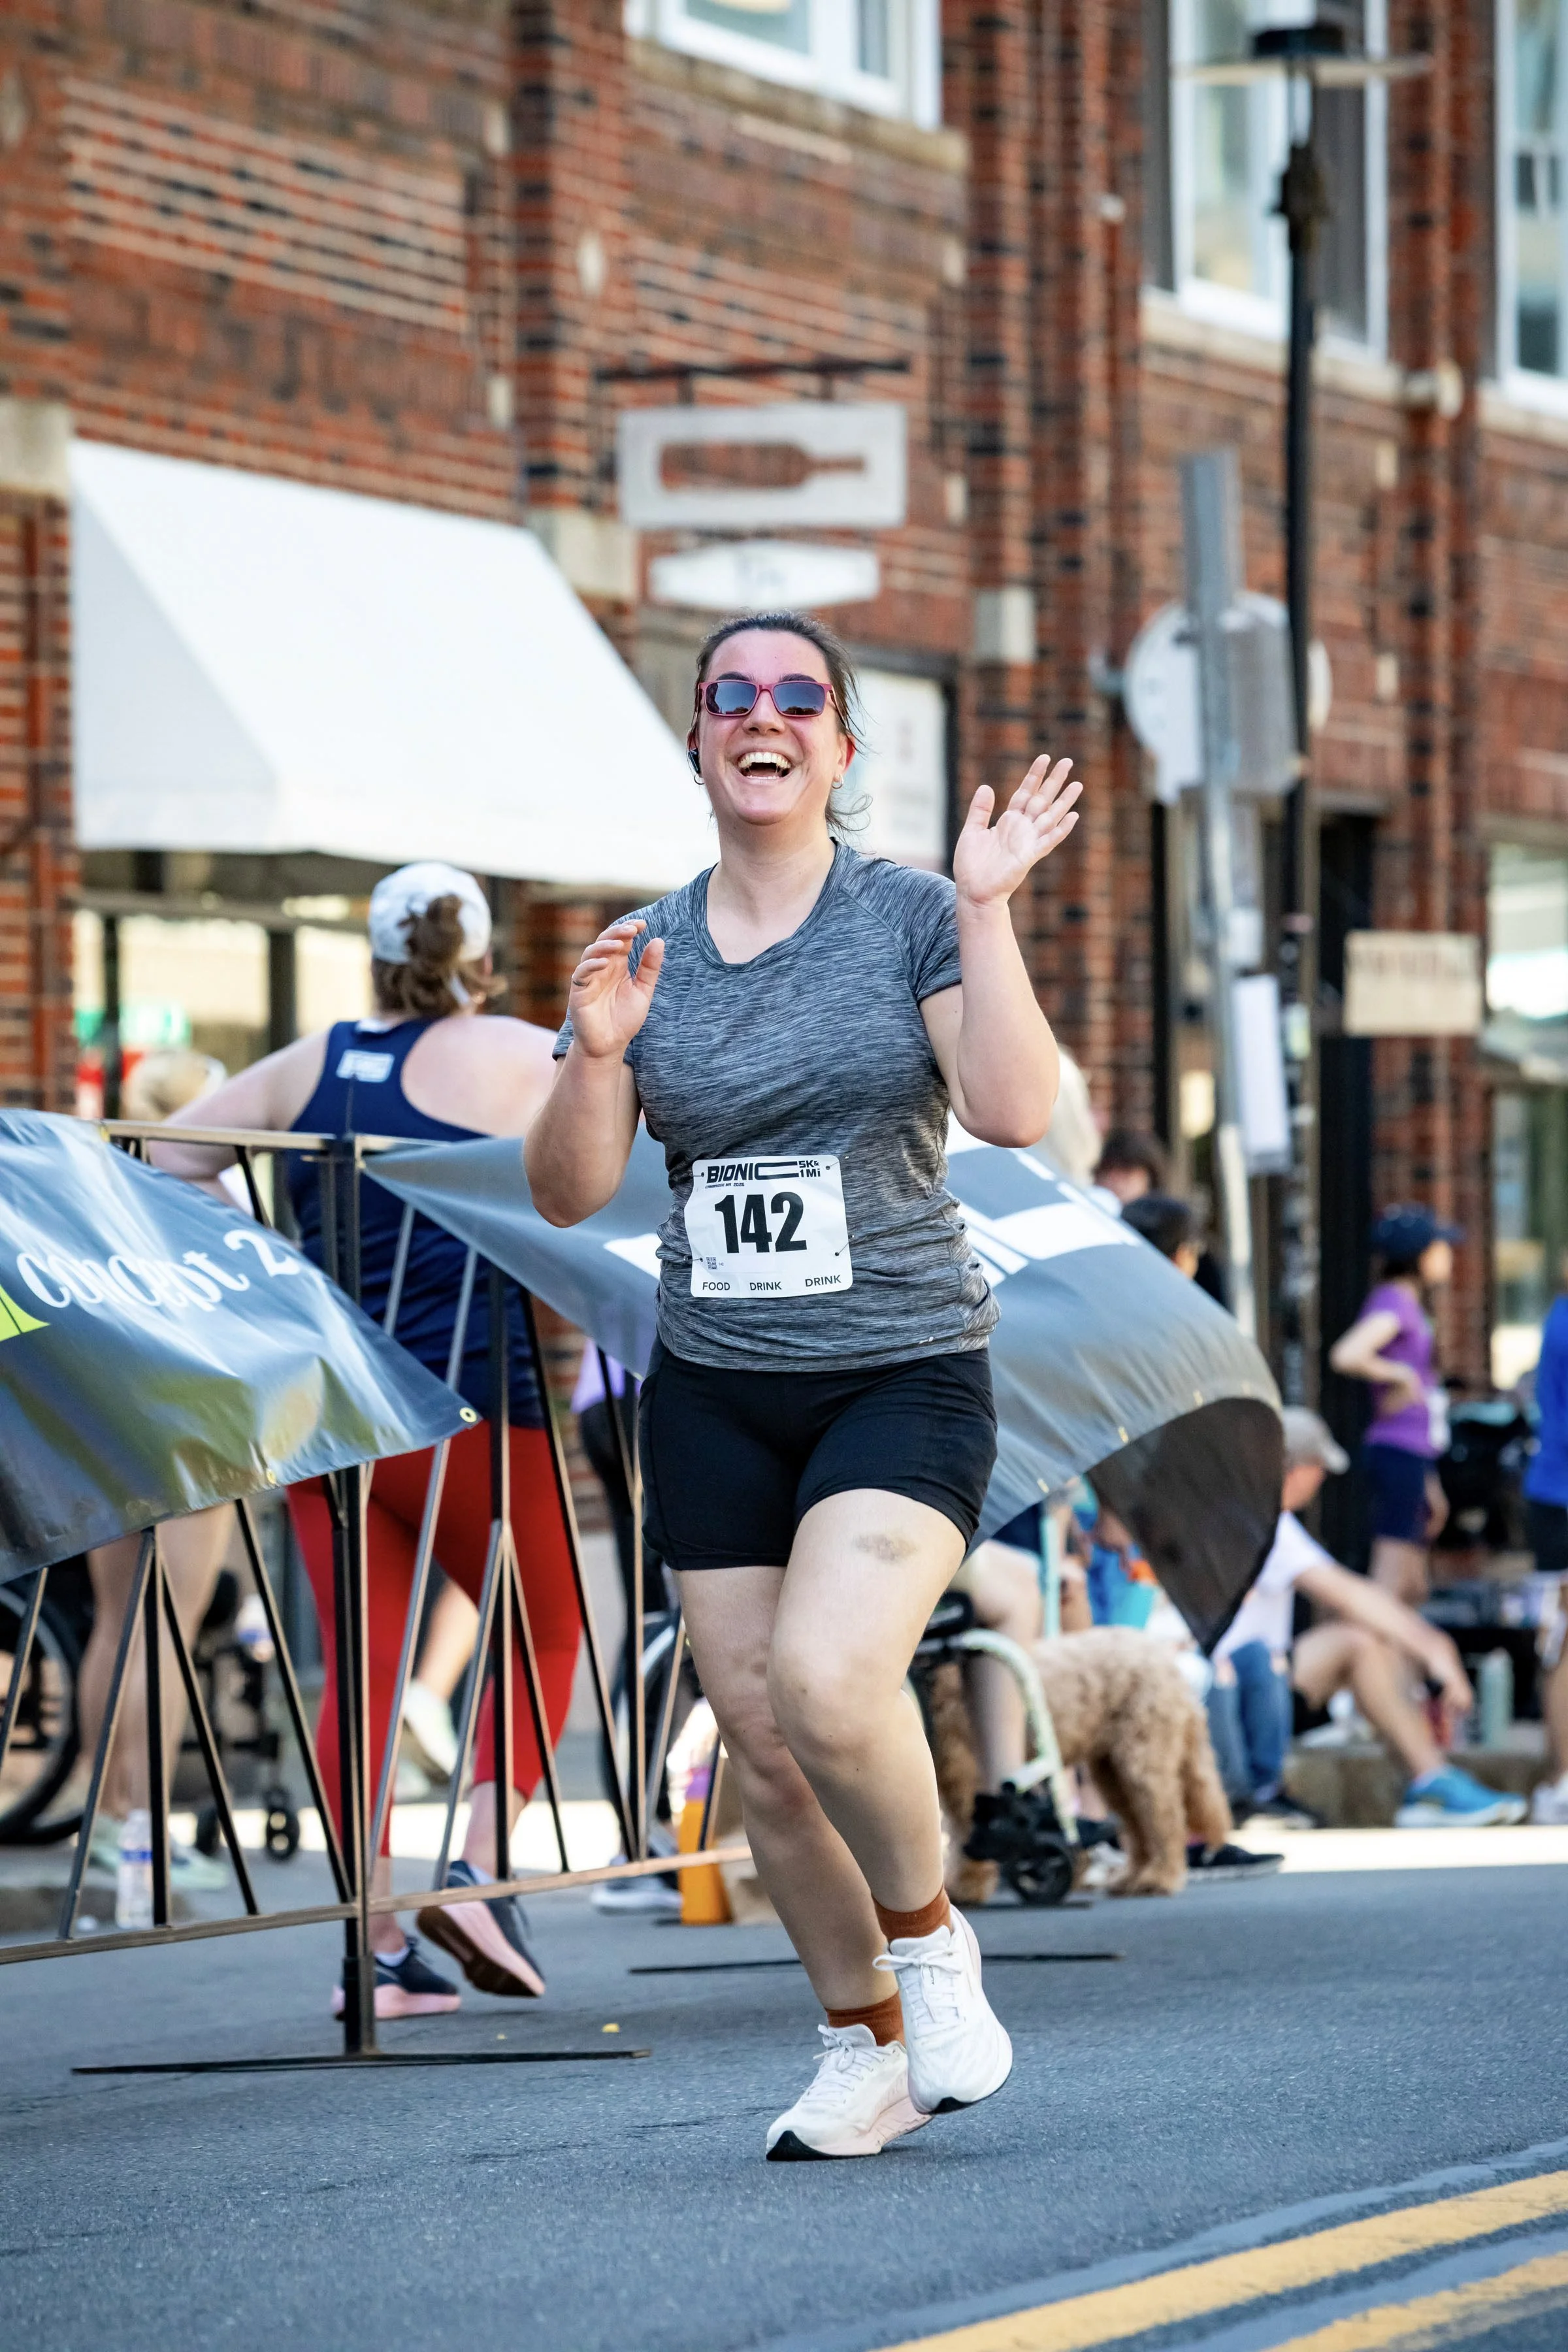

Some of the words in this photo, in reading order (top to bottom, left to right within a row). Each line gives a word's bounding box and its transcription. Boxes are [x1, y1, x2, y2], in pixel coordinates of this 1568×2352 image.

[706, 1161, 799, 1183] BIONIC
[798, 1160, 819, 1168] 5K&
[714, 1192, 808, 1254] 142
[223, 1230, 300, 1277] 2
[702, 1282, 730, 1291] FOOD
[749, 1281, 782, 1291] DRINK
[804, 1275, 841, 1287] DRINK
